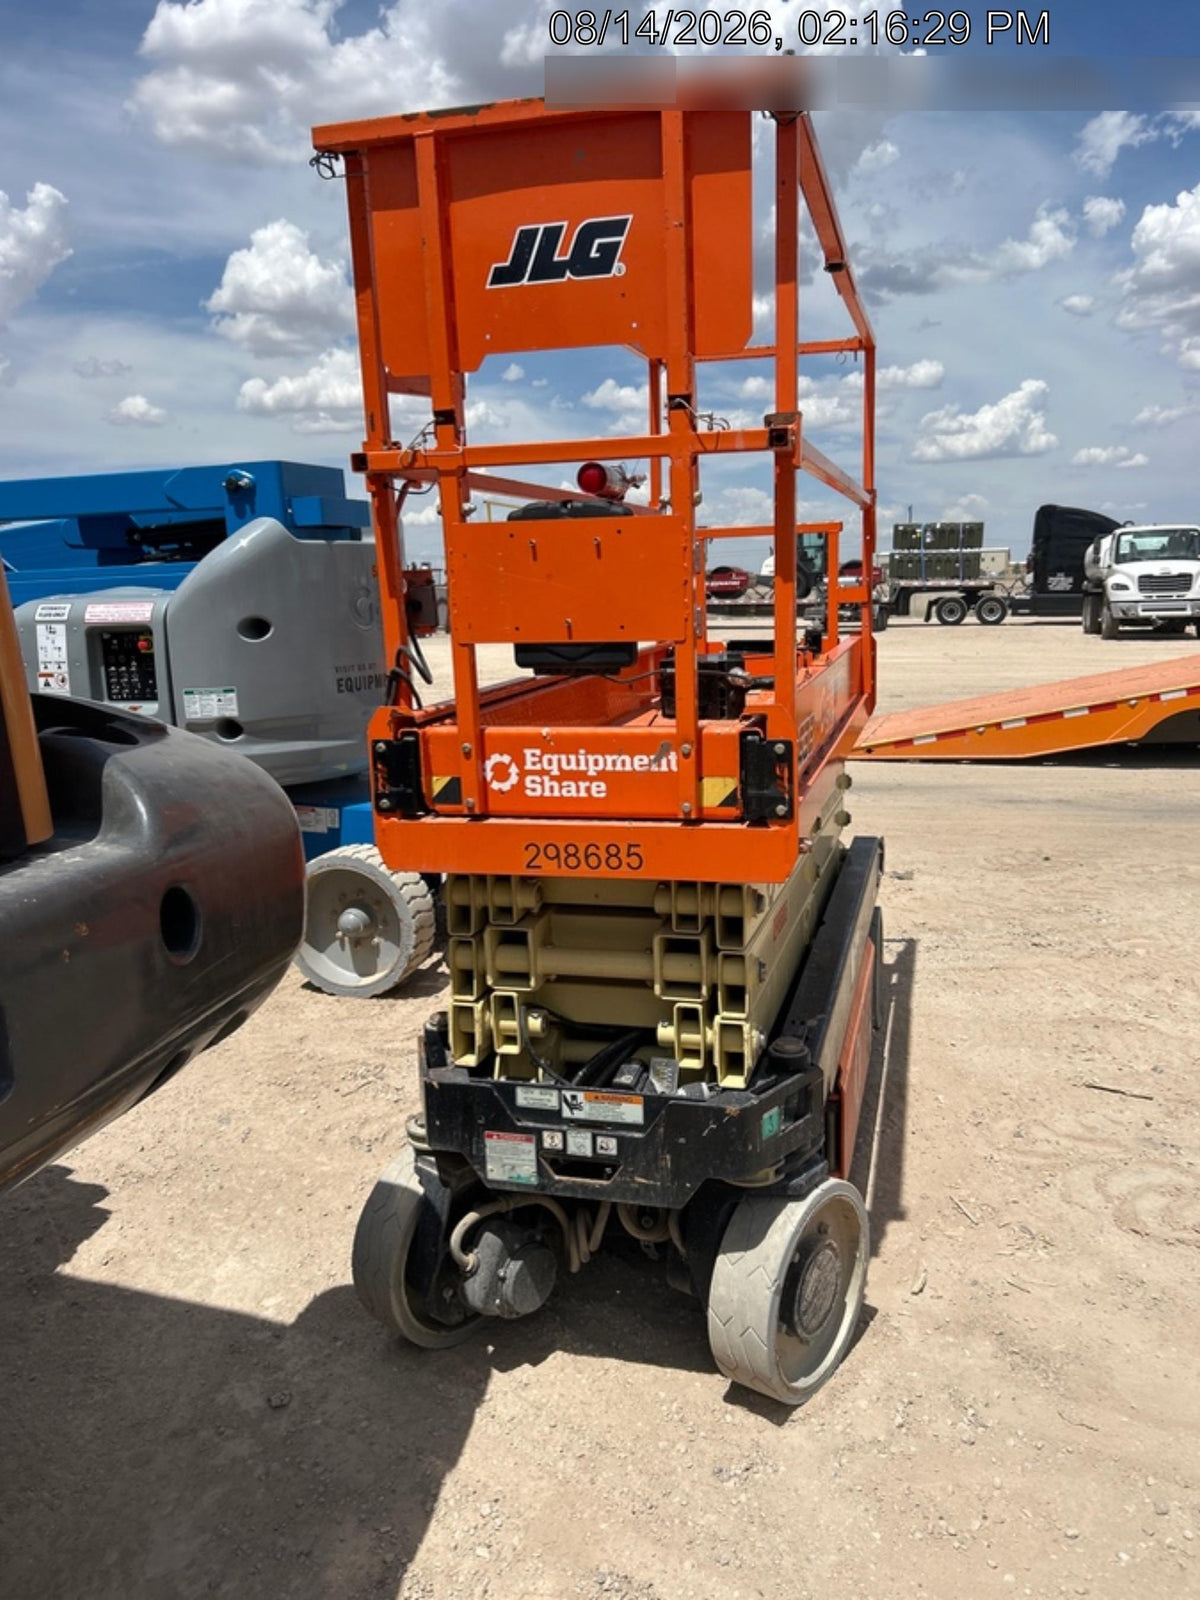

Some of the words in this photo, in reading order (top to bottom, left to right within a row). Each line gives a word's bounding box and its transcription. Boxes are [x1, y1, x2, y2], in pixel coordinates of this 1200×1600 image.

[485, 214, 633, 289] JLG
[523, 748, 679, 776] Equipment
[524, 775, 608, 798] Share
[524, 842, 644, 870] 298685
